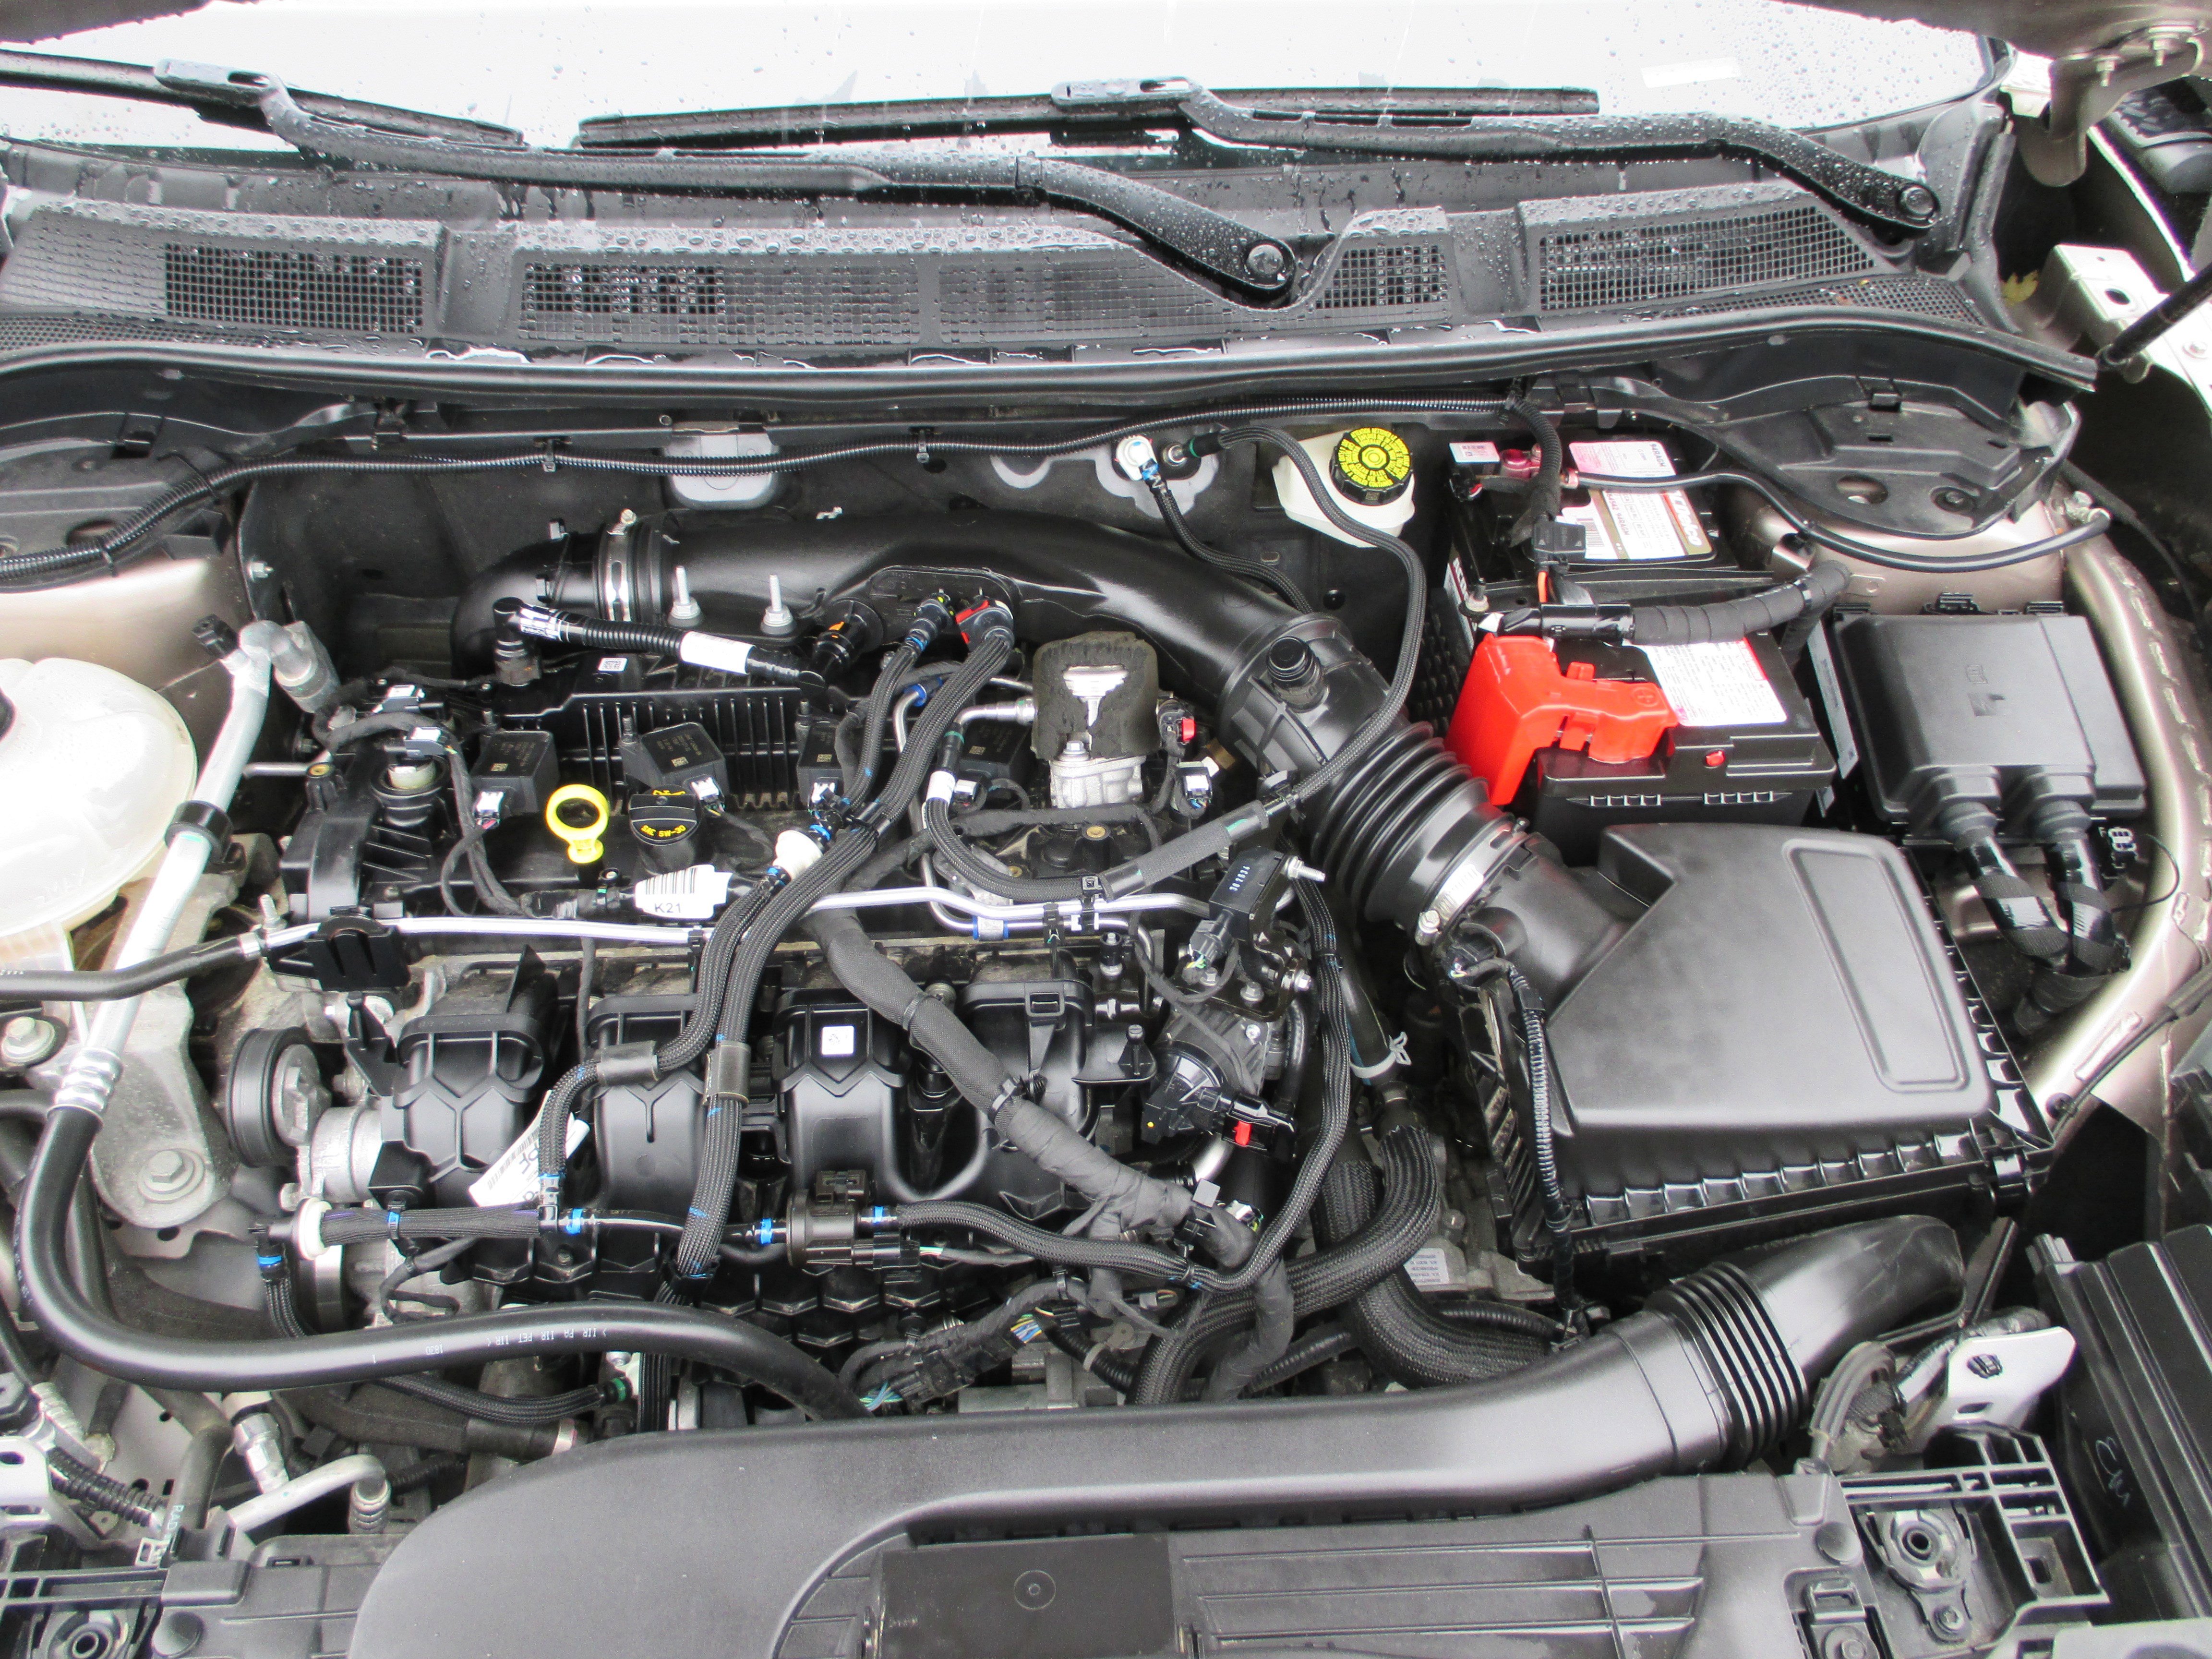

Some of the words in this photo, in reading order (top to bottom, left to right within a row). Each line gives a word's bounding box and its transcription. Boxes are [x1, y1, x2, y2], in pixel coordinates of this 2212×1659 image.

[640, 825, 656, 836] SAE
[657, 824, 686, 837] 5W-30
[654, 902, 681, 913] K21
